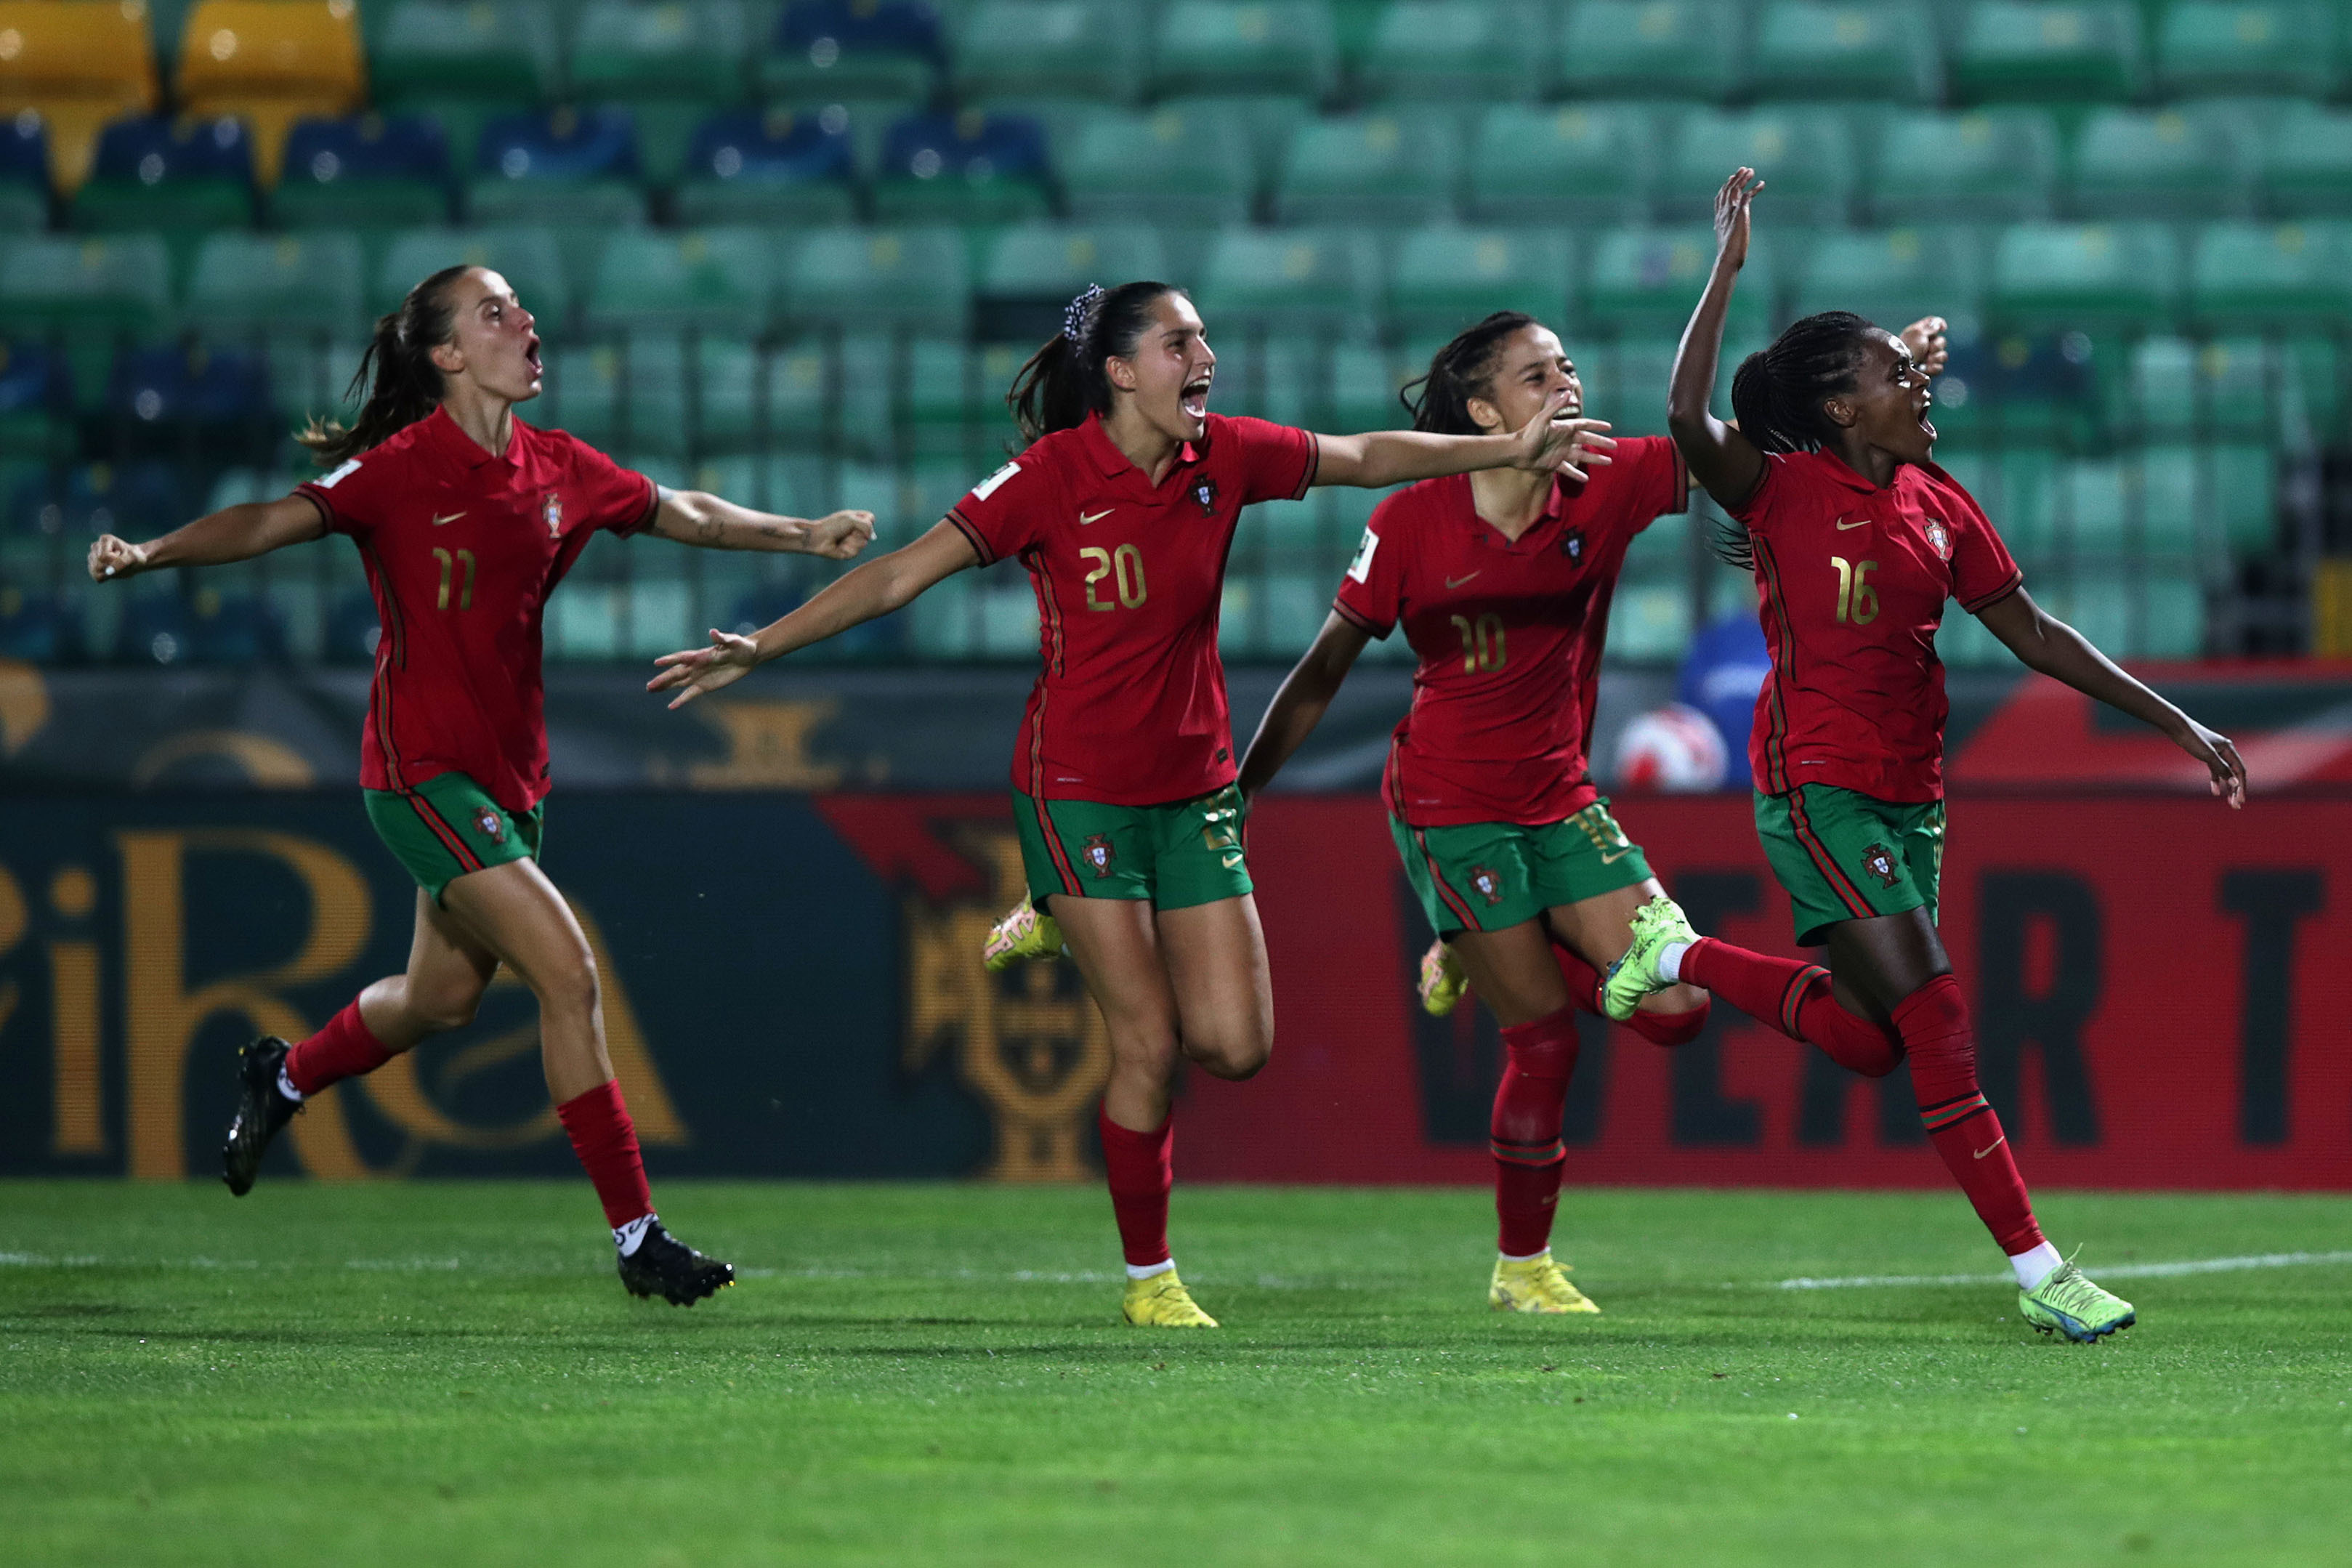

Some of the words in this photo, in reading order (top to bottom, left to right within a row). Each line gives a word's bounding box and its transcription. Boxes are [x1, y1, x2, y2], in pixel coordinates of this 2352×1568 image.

[432, 547, 477, 610] 11
[1079, 543, 1148, 611] 20
[1830, 556, 1880, 626] 16
[1450, 613, 1507, 676] 10
